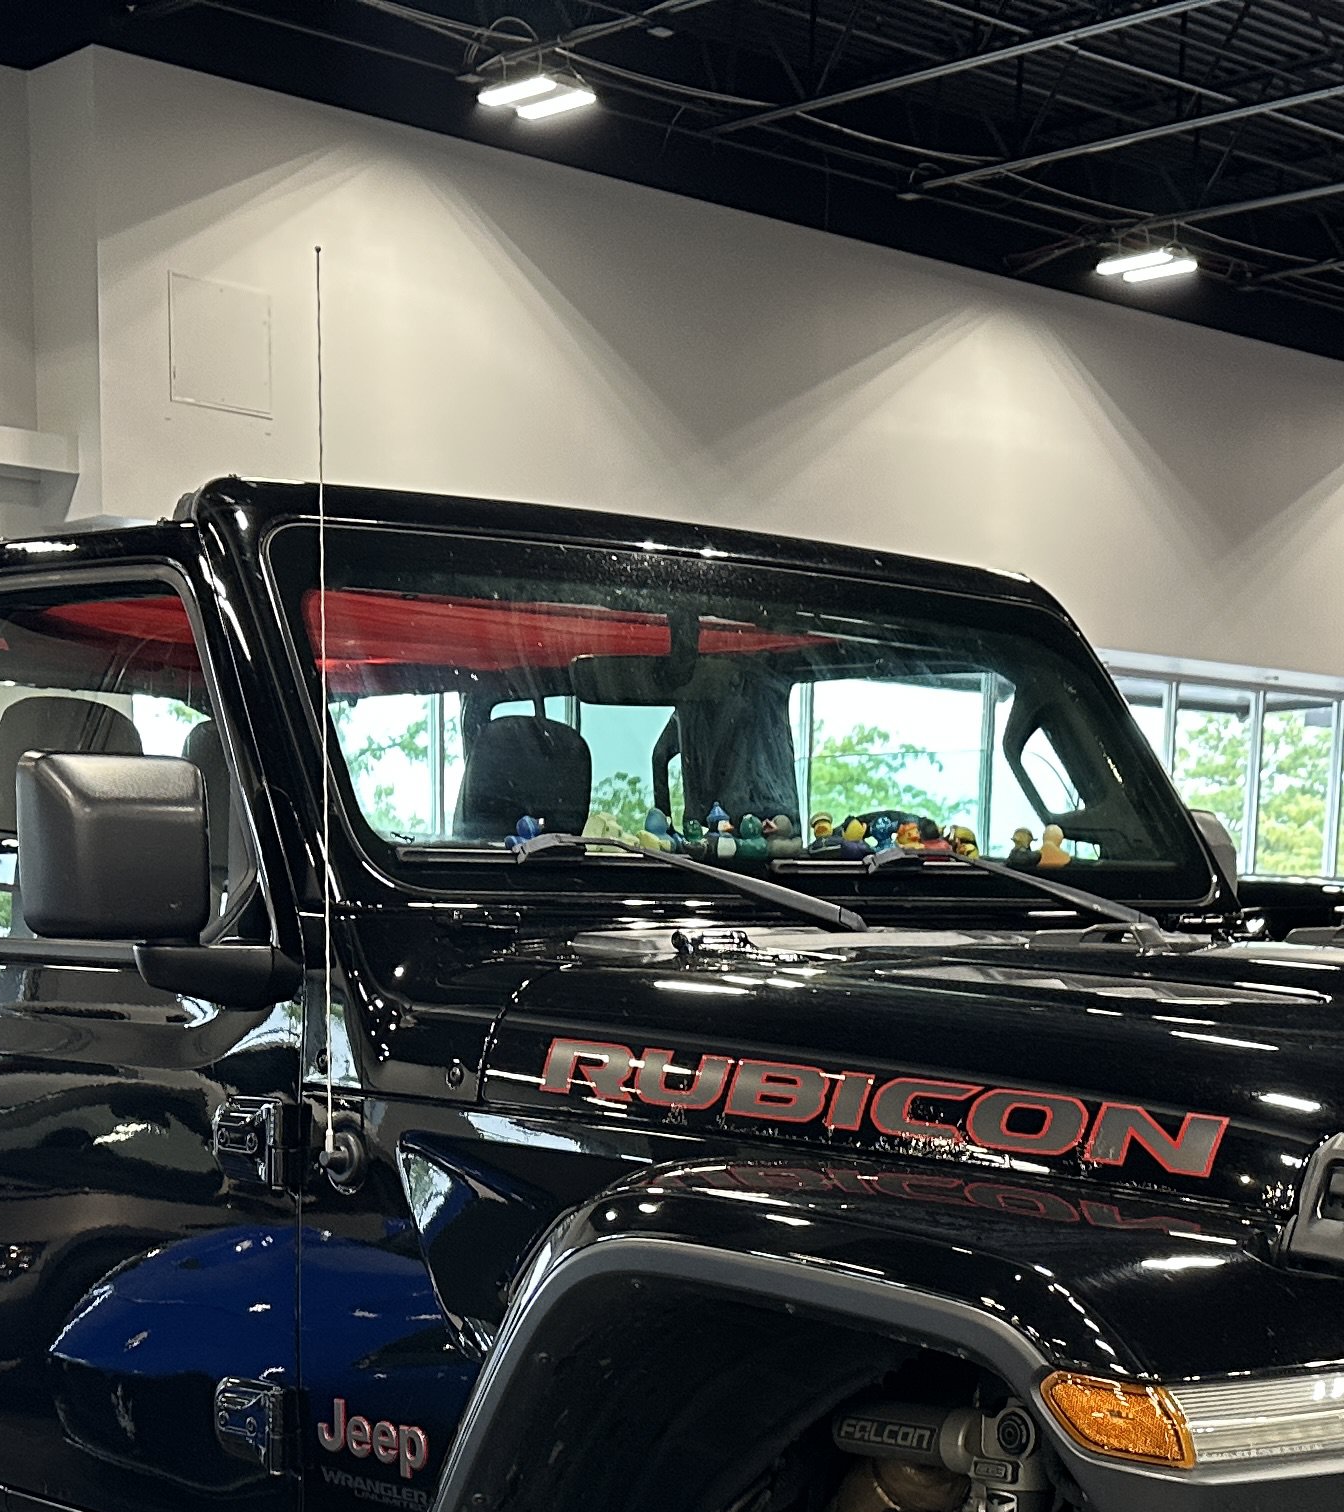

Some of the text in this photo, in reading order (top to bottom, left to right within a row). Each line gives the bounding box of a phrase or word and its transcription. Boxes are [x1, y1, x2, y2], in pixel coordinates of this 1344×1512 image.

[538, 1037, 1231, 1178] RUBICON
[317, 1397, 429, 1479] Jeep
[840, 1418, 931, 1450] FALCON
[320, 1463, 429, 1505] WRANGLER
